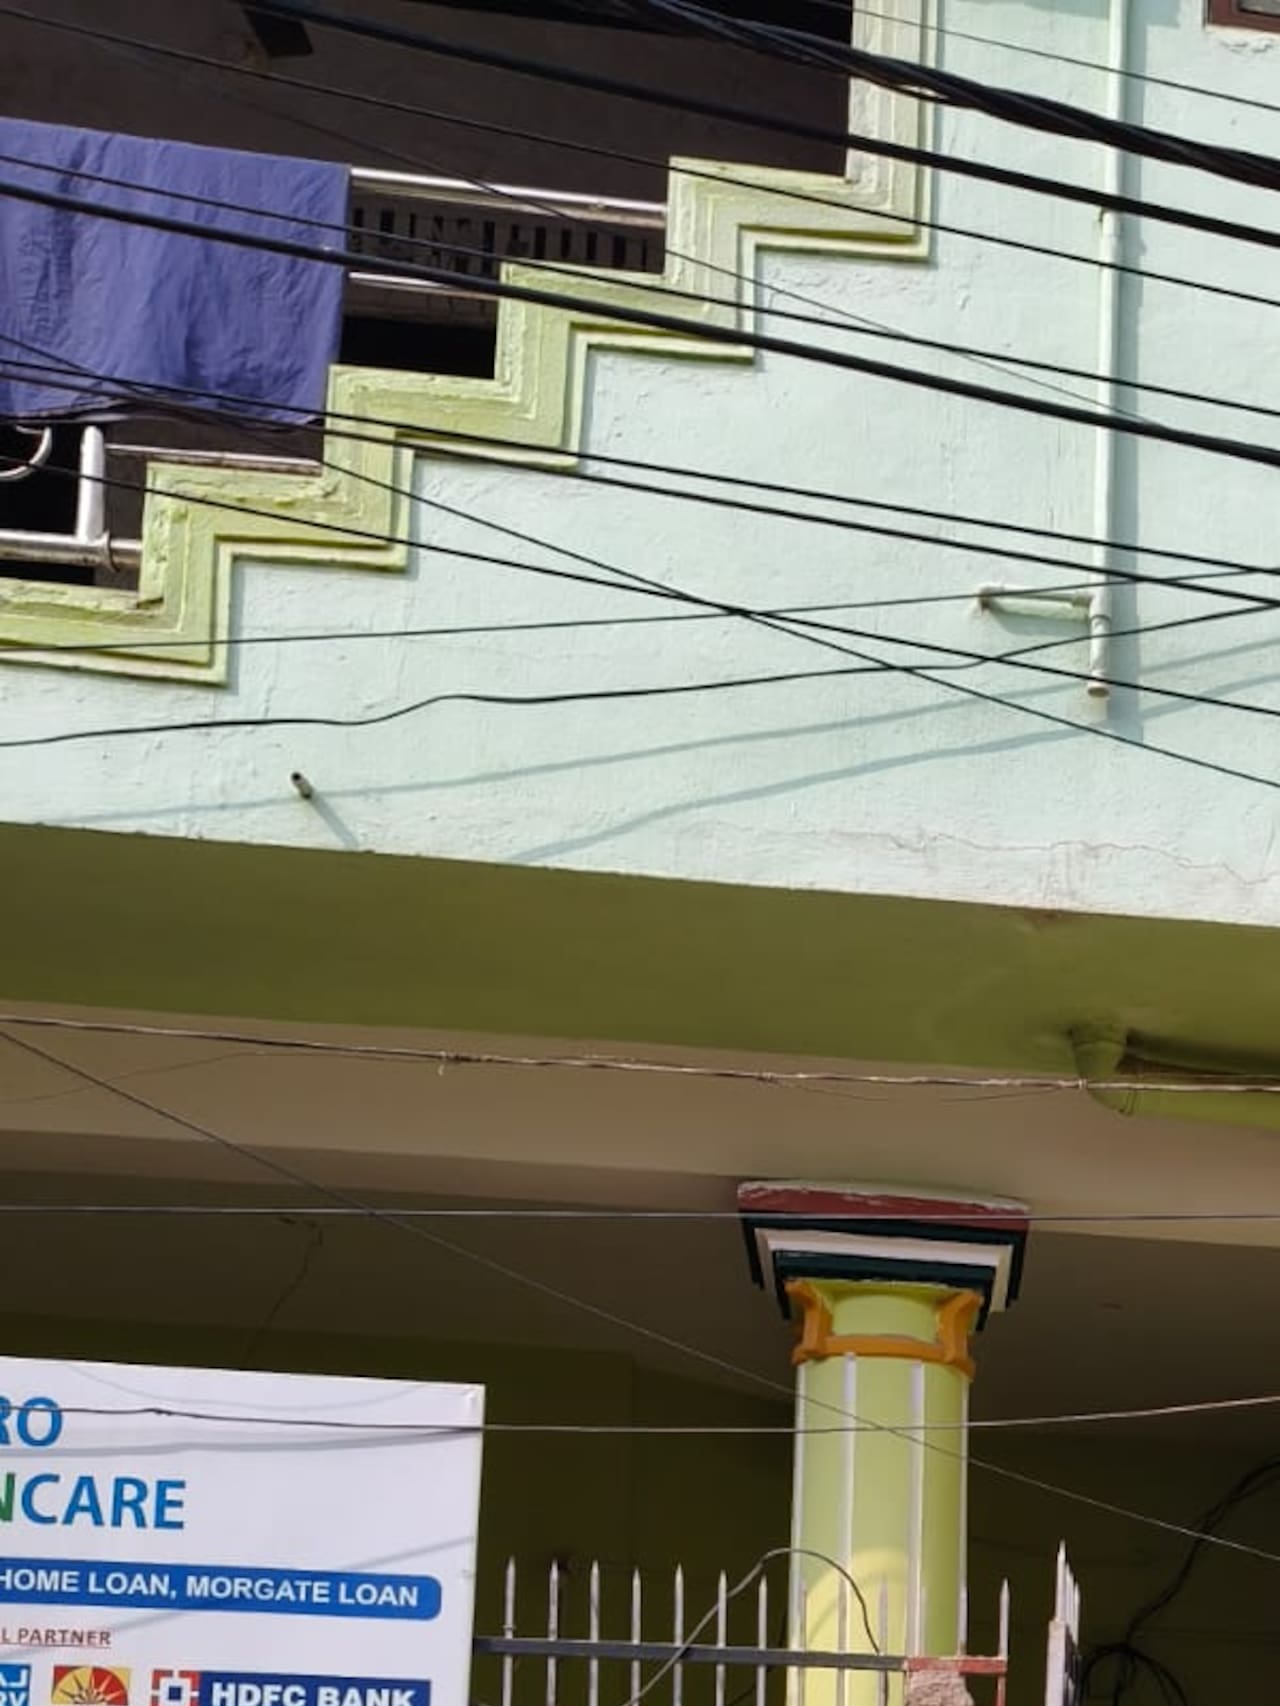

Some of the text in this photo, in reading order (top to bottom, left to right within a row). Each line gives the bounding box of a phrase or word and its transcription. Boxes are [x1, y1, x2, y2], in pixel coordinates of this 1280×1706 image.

[0, 1568, 419, 1607] HOME LOAN, MORGATE LOAN
[18, 1627, 112, 1645] PARTNER
